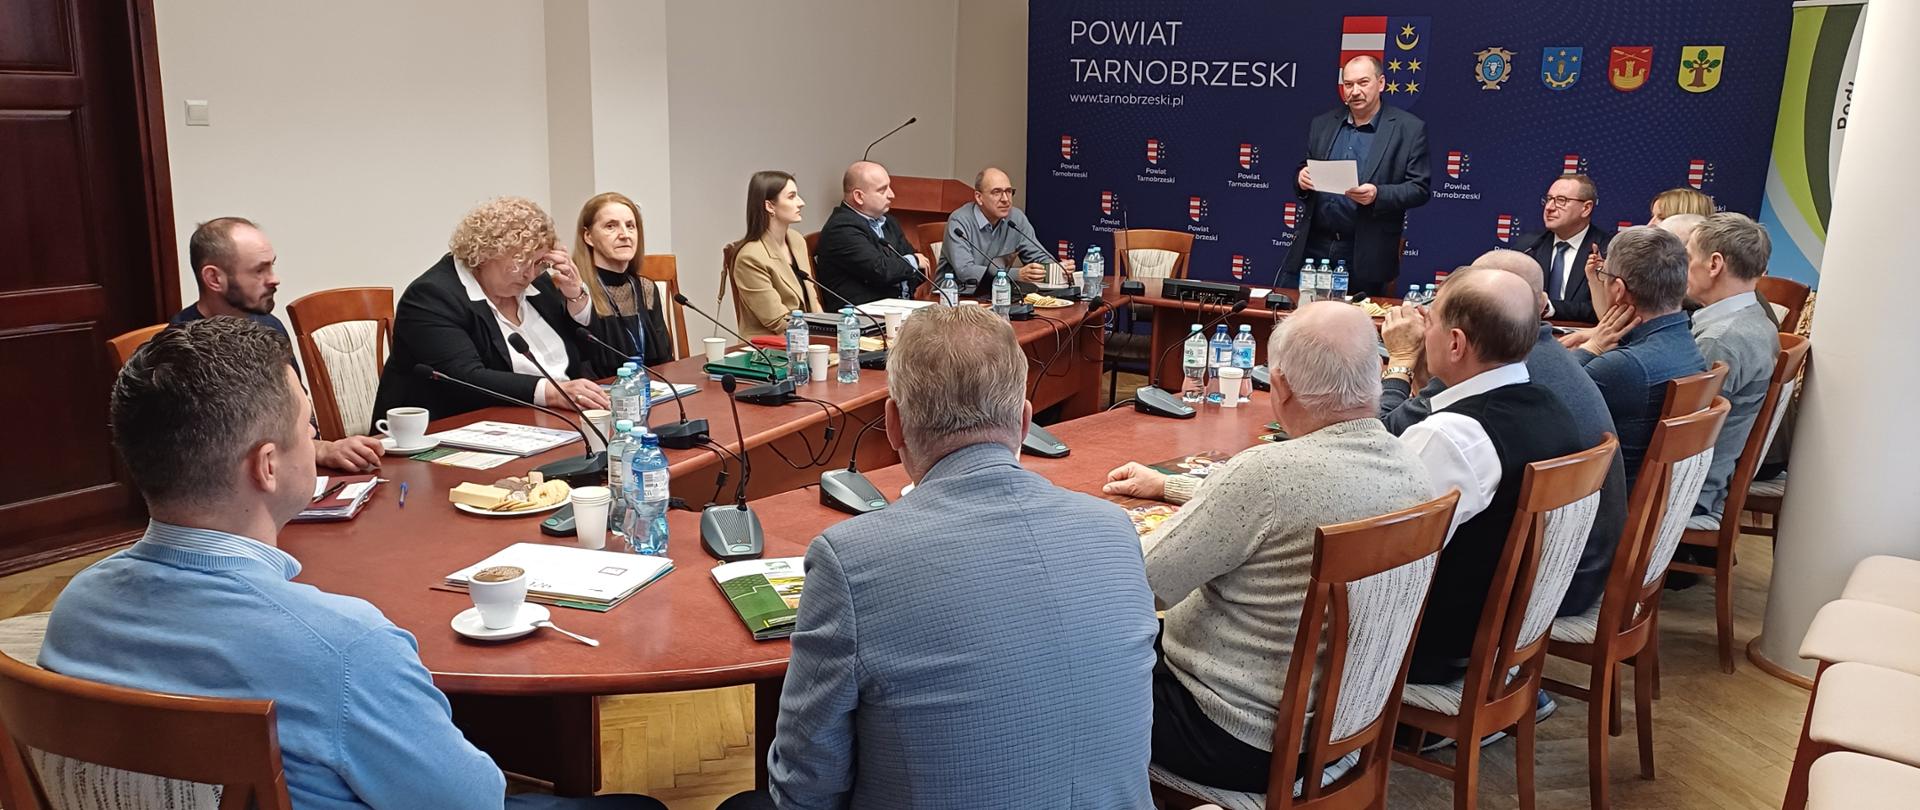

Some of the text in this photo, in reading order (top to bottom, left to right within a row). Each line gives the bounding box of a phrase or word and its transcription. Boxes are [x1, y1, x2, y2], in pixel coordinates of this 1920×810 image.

[1070, 20, 1183, 46] POWIAT
[1070, 58, 1297, 88] TARNOBRZESKI
[1070, 93, 1184, 108] www.tarnobrzeski.pl
[1060, 162, 1080, 170] Powiat
[1052, 169, 1088, 178] Tarnobrzeski
[1145, 167, 1167, 176] Powiat
[1137, 175, 1176, 184] Tarnobrzeski
[1237, 172, 1261, 181] Powiat
[1228, 180, 1270, 189] Tarnobrzeski
[1444, 182, 1471, 191] Powiat
[1433, 190, 1481, 200] Tarnobrzeski
[1100, 217, 1121, 226] Powiat
[1187, 224, 1210, 233] Powiat
